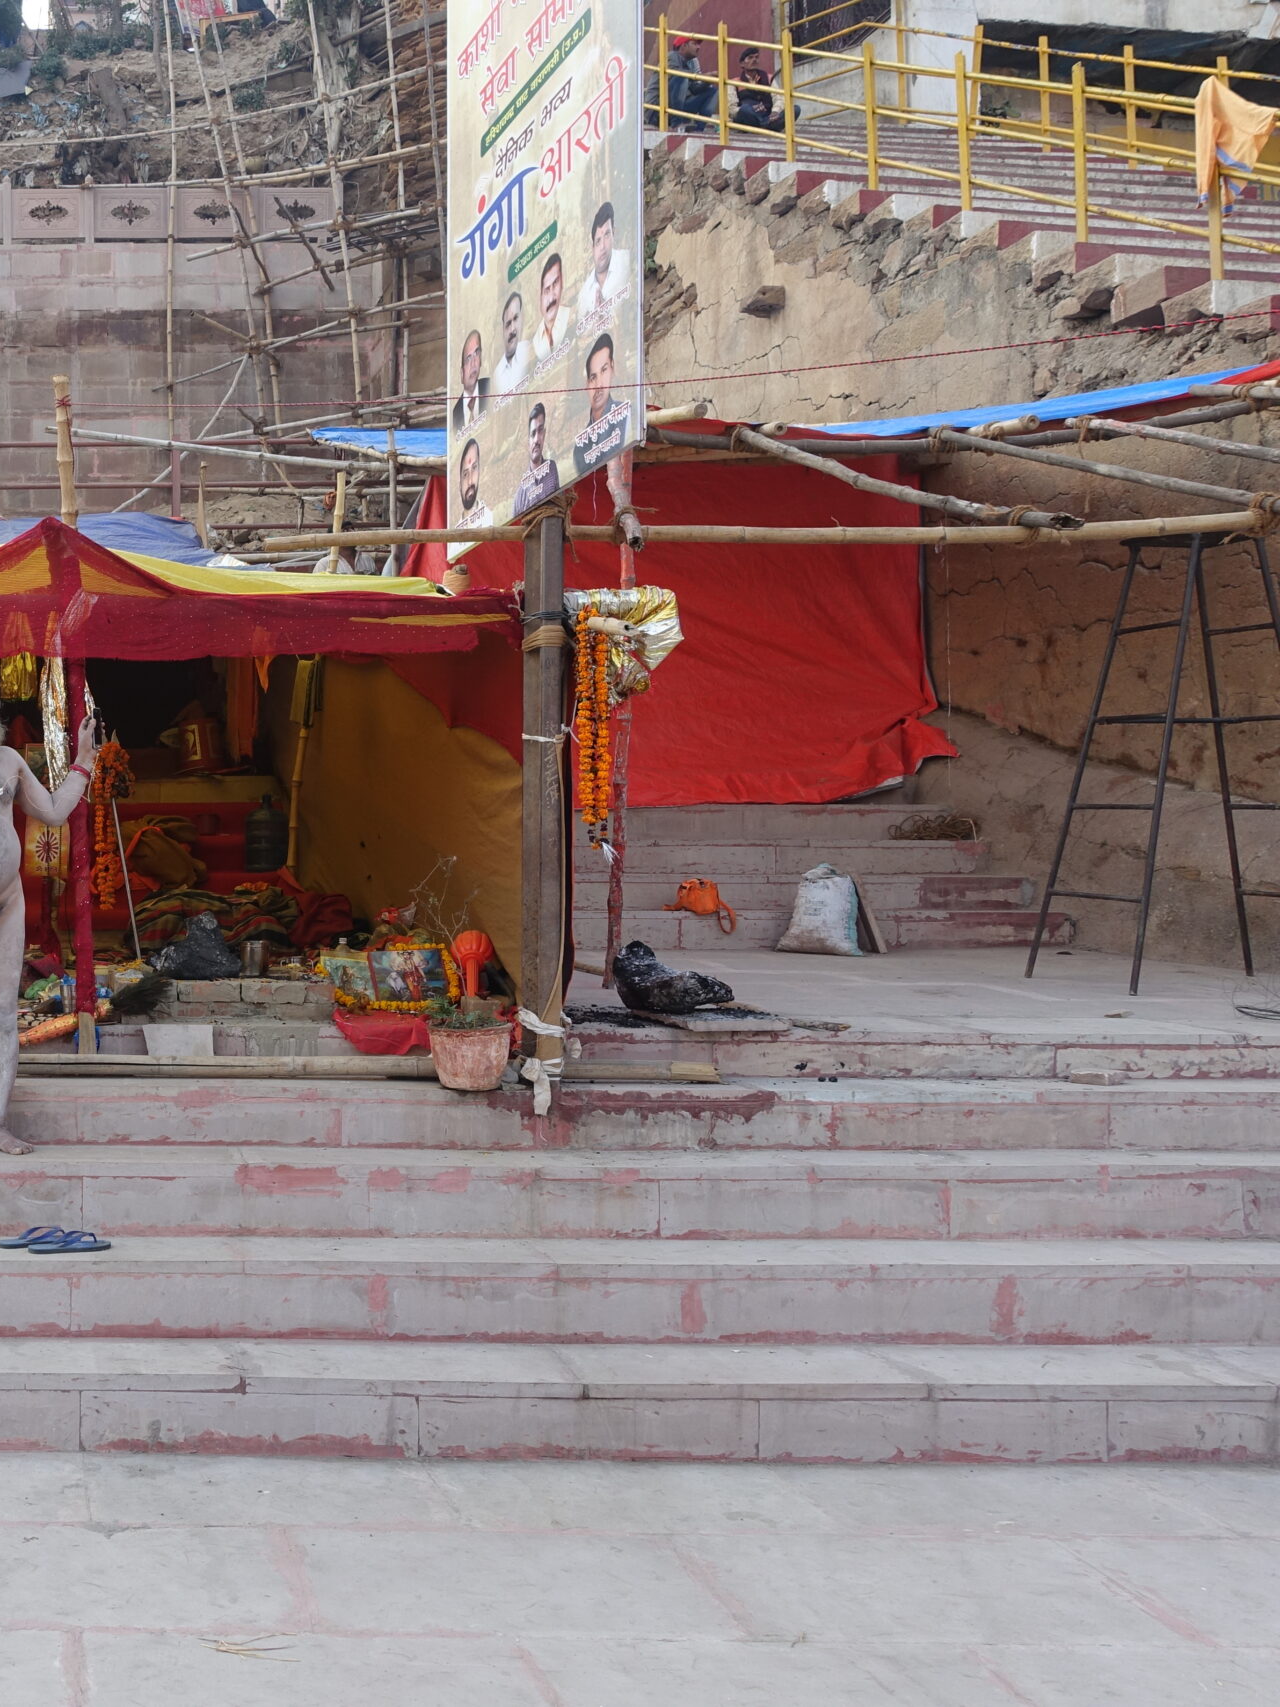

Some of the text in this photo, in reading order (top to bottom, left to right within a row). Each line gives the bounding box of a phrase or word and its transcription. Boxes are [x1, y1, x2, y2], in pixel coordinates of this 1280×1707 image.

[479, 47, 518, 115] सेवा
[530, 50, 560, 92] वाराणसी
[495, 76, 573, 178] दैनिक भव्य
[456, 166, 540, 279] गंगा
[540, 55, 628, 198] आरती
[587, 414, 609, 442] कुमार
